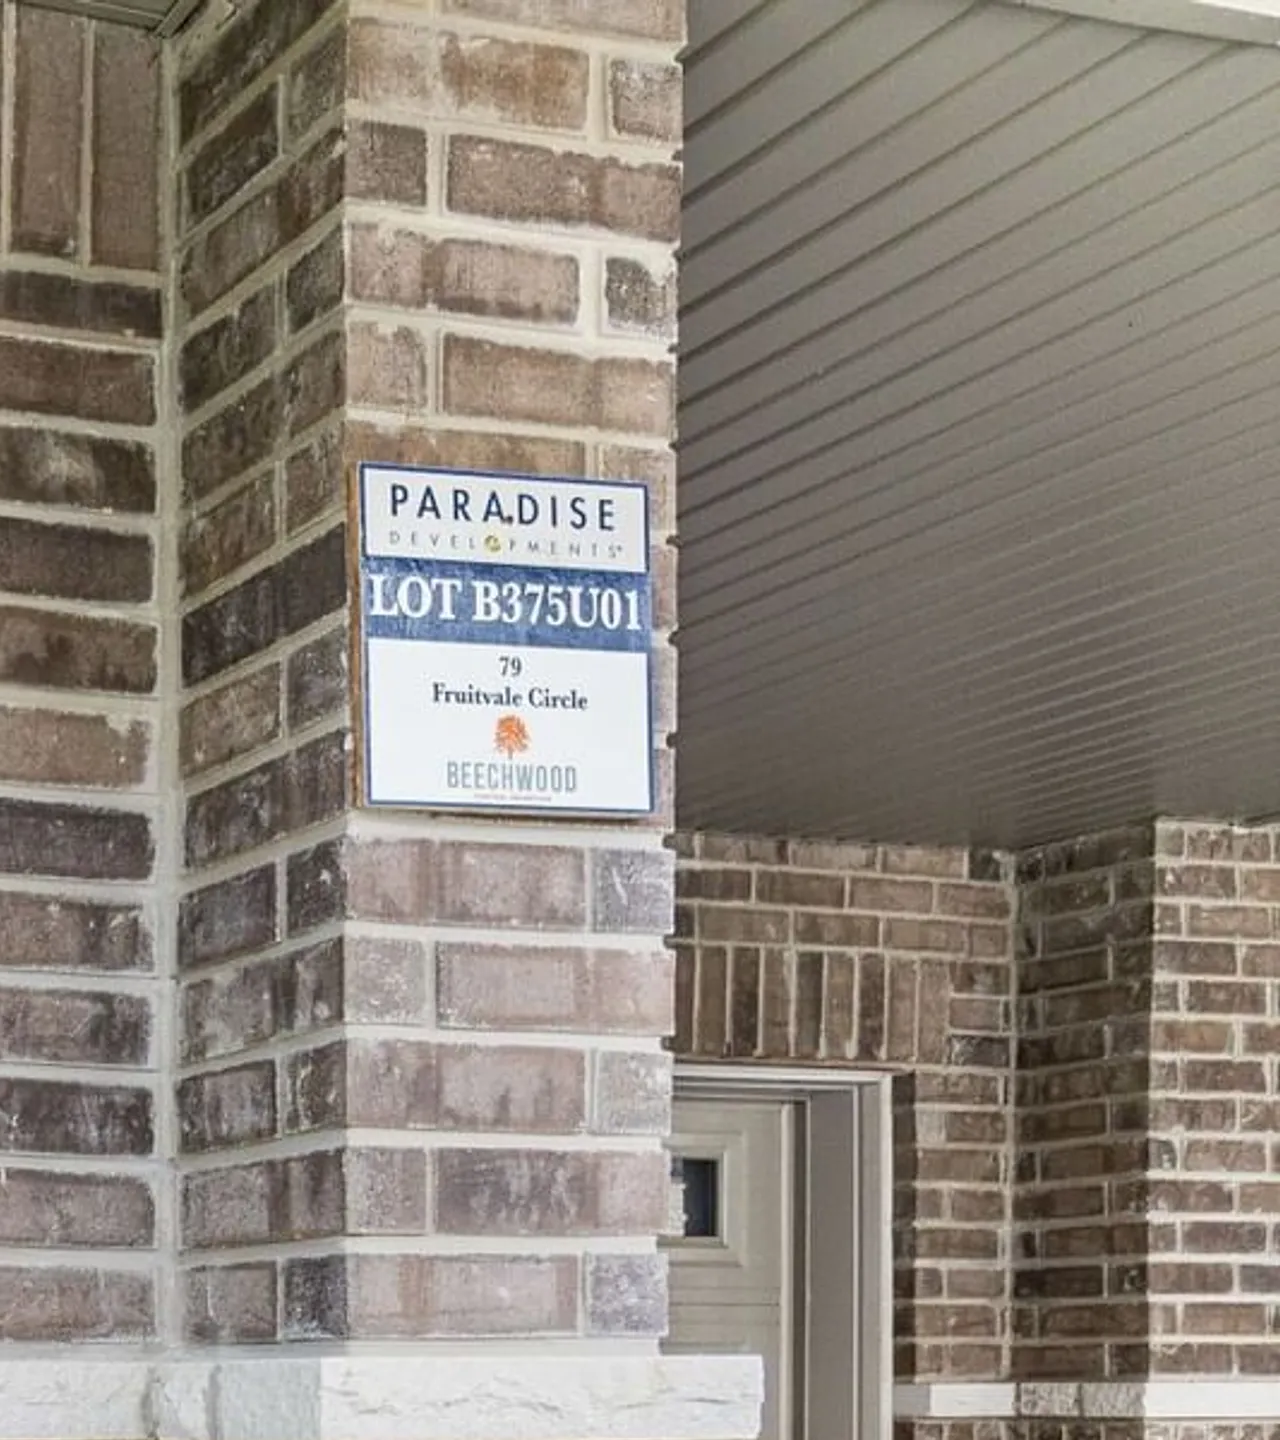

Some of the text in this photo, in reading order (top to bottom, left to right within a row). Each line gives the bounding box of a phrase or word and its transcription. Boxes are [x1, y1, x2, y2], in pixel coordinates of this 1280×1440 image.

[391, 484, 616, 531] PARADISE
[369, 573, 641, 631] LOT B375U01
[499, 656, 523, 677] 79
[432, 682, 589, 710] Fruitvale Circle
[446, 761, 577, 793] BEECHWOOD
